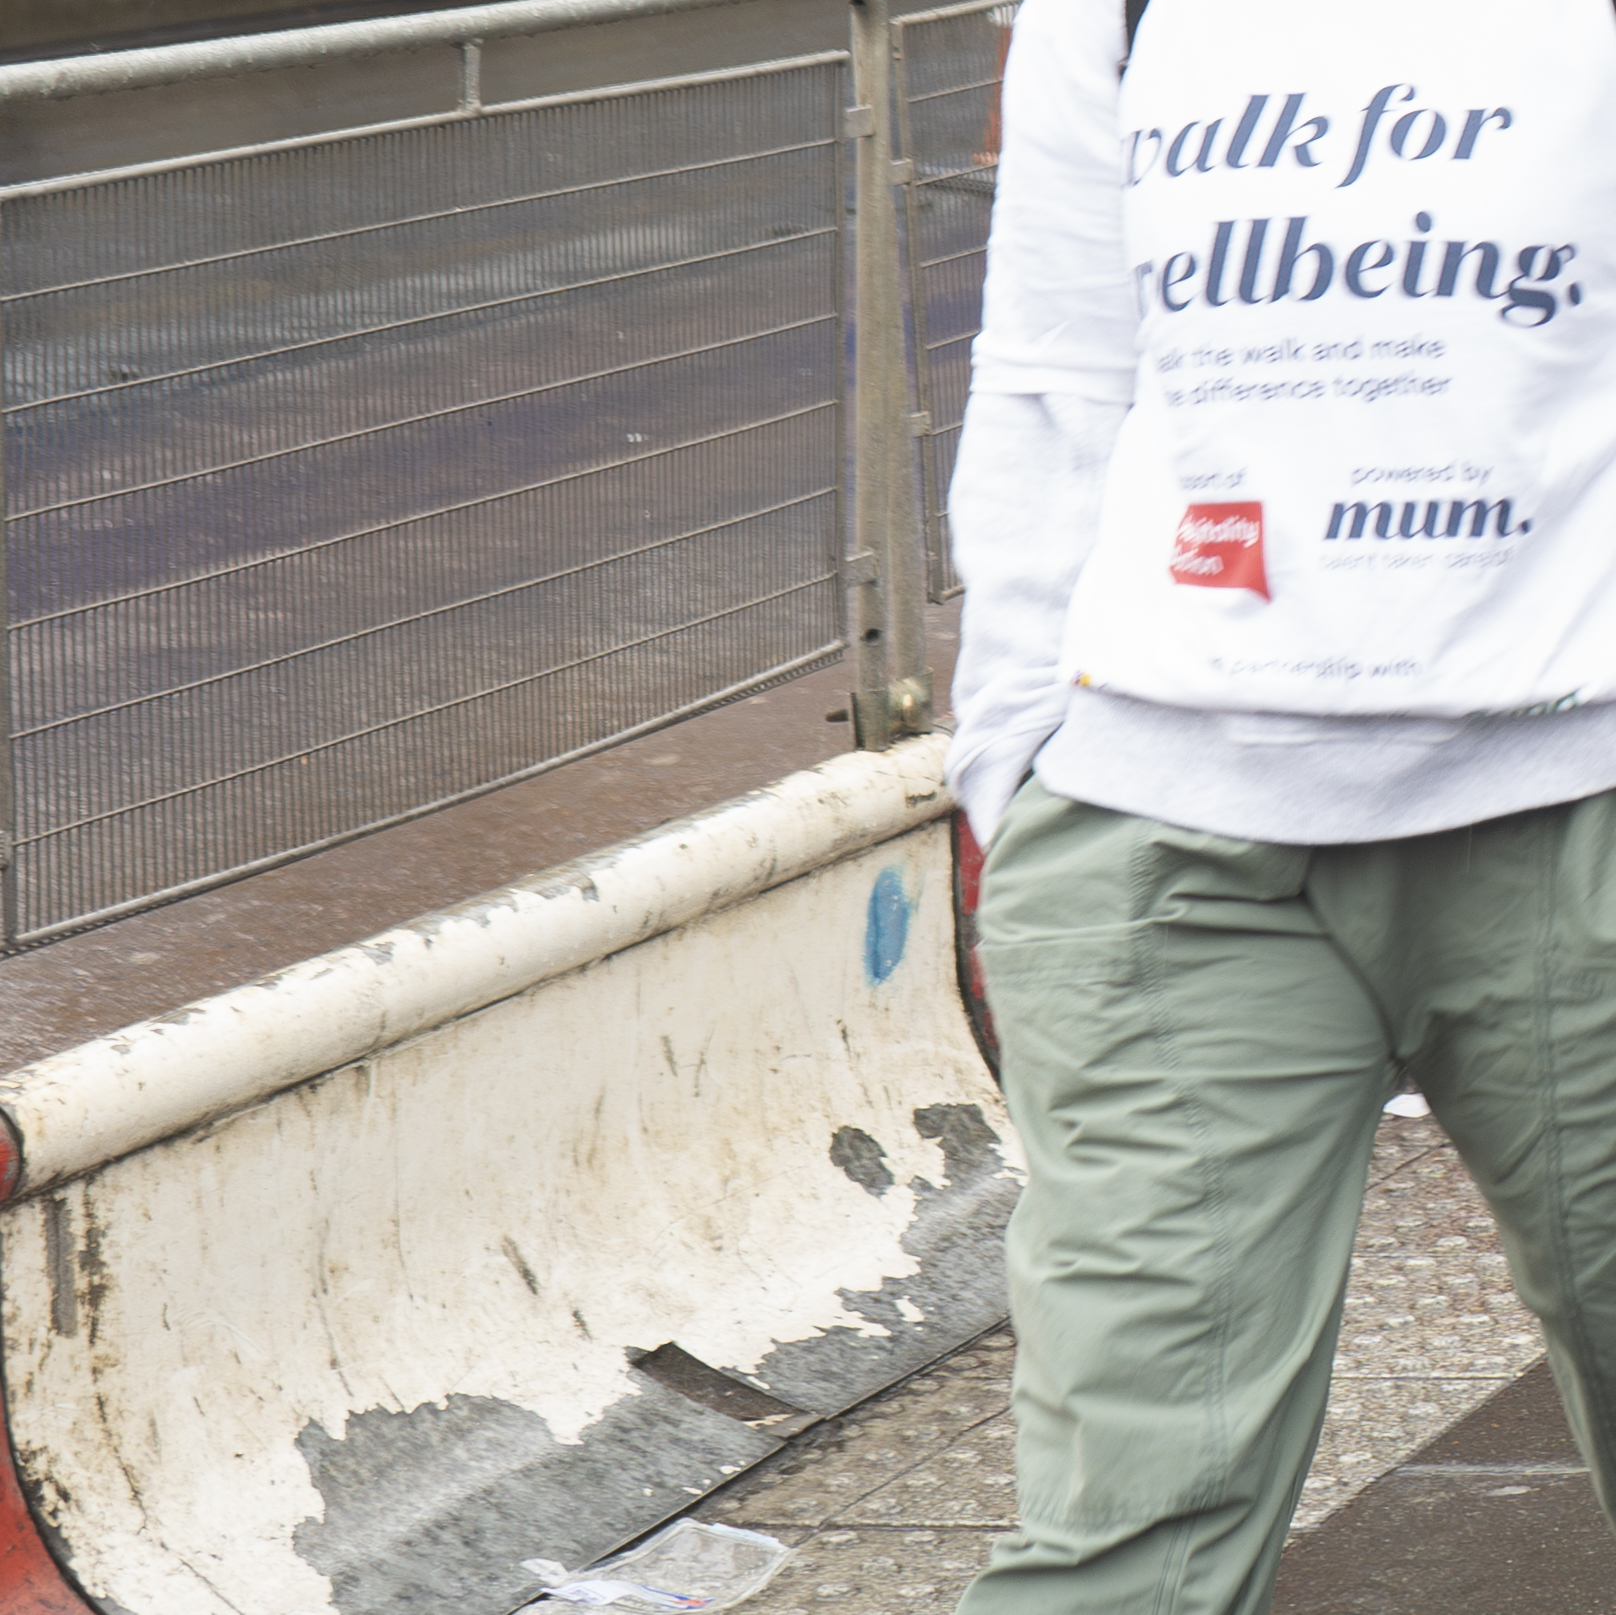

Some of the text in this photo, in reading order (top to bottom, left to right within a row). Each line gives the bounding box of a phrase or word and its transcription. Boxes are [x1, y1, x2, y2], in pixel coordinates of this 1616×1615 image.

[1334, 82, 1514, 189] for
[1241, 335, 1306, 365] walk
[1311, 333, 1365, 363] and
[1369, 331, 1448, 360] make
[1190, 376, 1326, 408] difference
[1331, 369, 1453, 405] together
[1323, 497, 1532, 541] mum.
